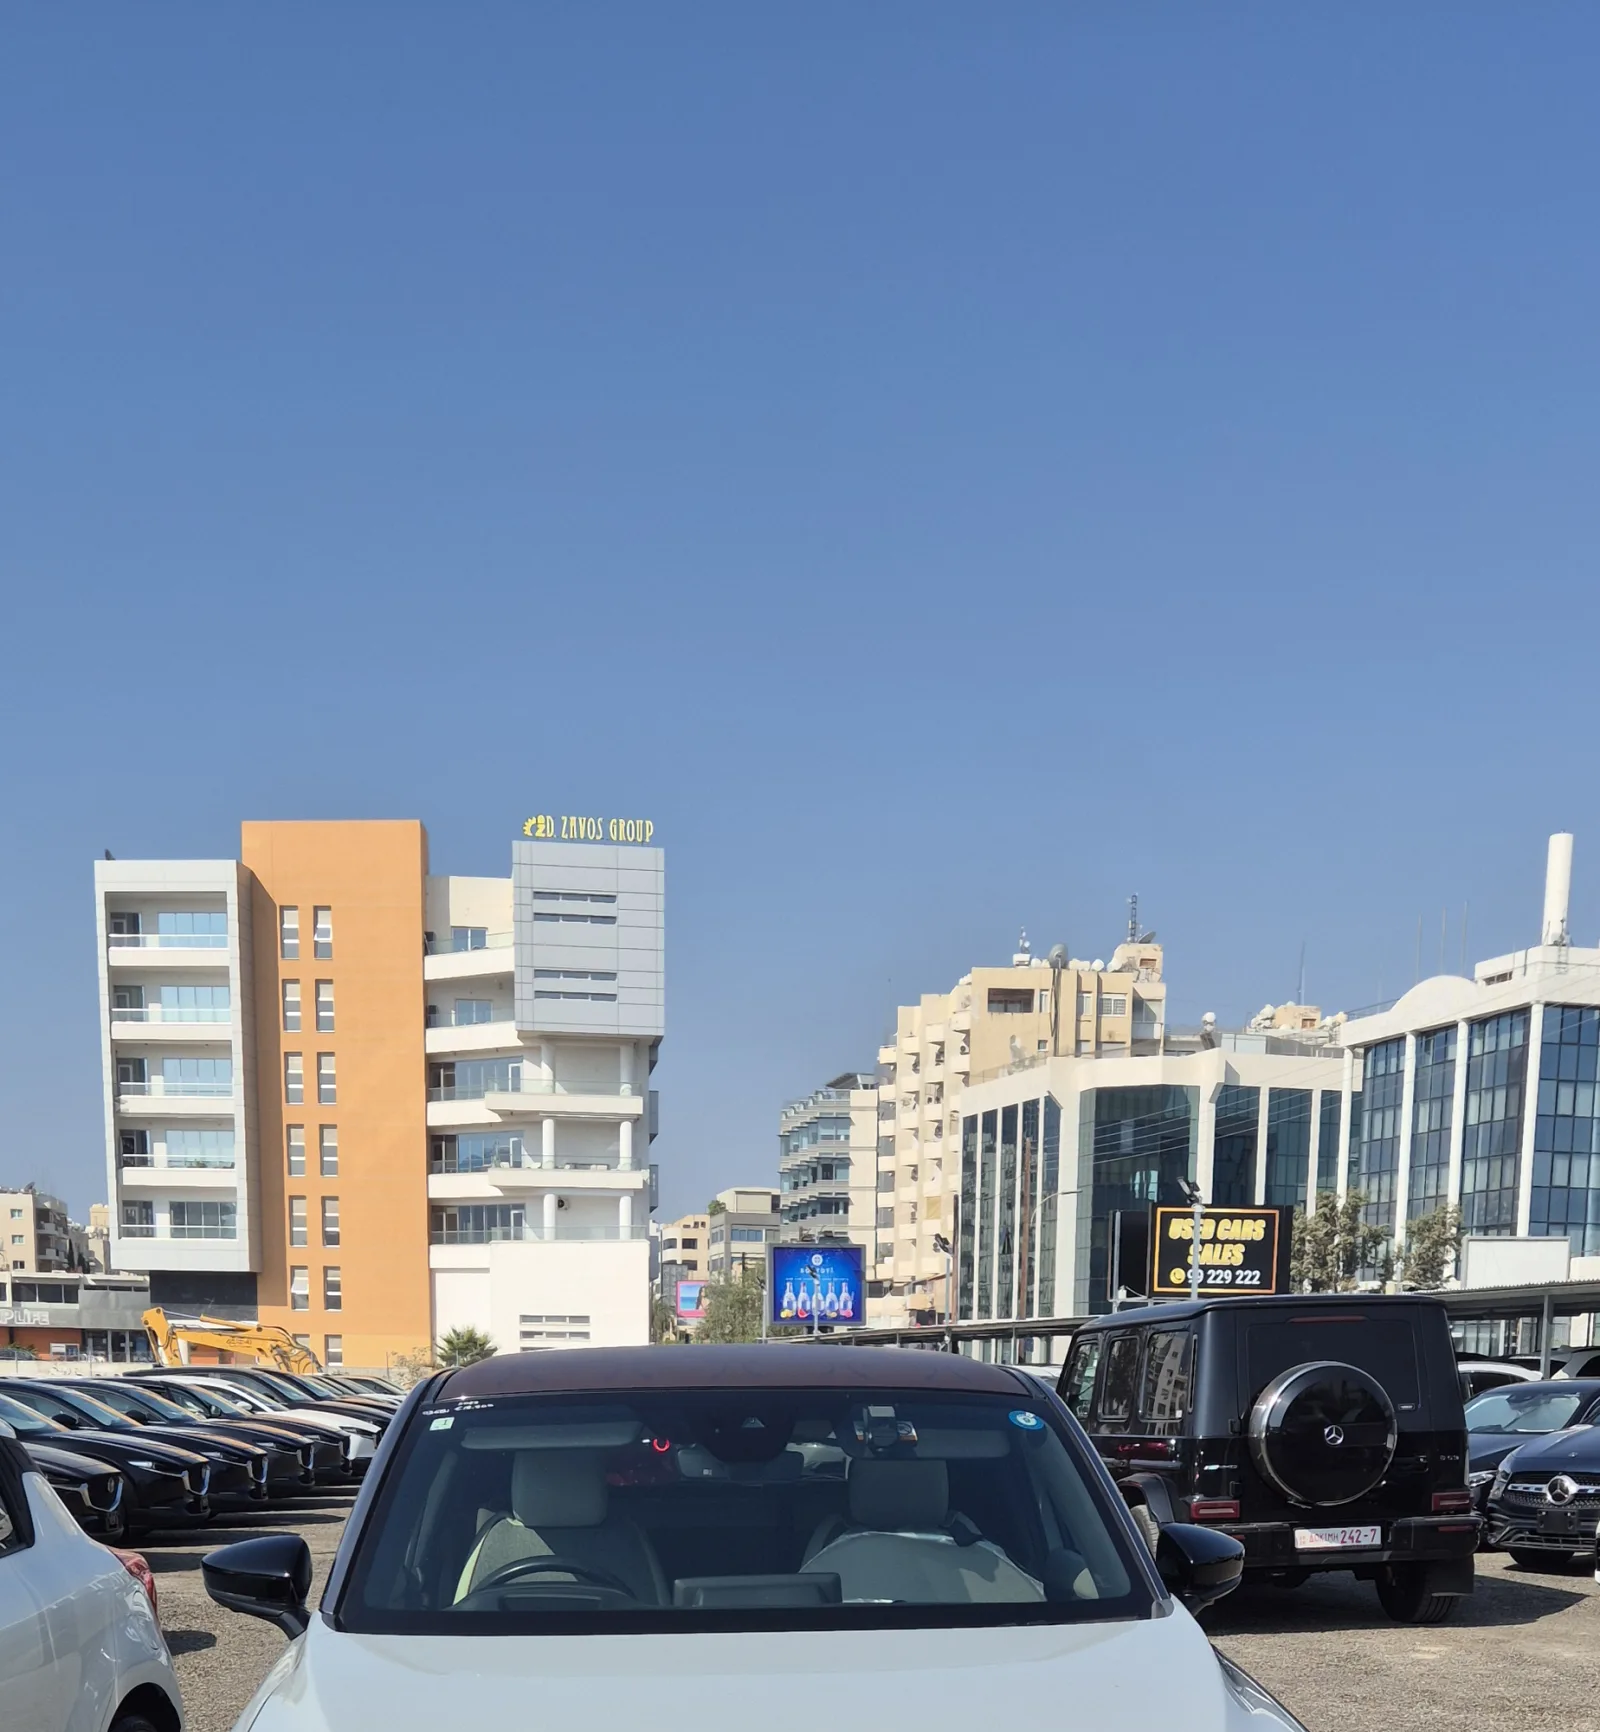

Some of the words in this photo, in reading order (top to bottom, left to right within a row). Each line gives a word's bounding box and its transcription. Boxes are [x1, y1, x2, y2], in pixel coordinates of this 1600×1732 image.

[561, 816, 603, 840] ZAVOS
[609, 818, 654, 843] GROUP
[1216, 1218, 1266, 1241] CARS
[1187, 1243, 1245, 1266] SALES
[1207, 1269, 1232, 1285] 229
[1235, 1270, 1261, 1285] 222
[1340, 1528, 1377, 1544] 242-7
